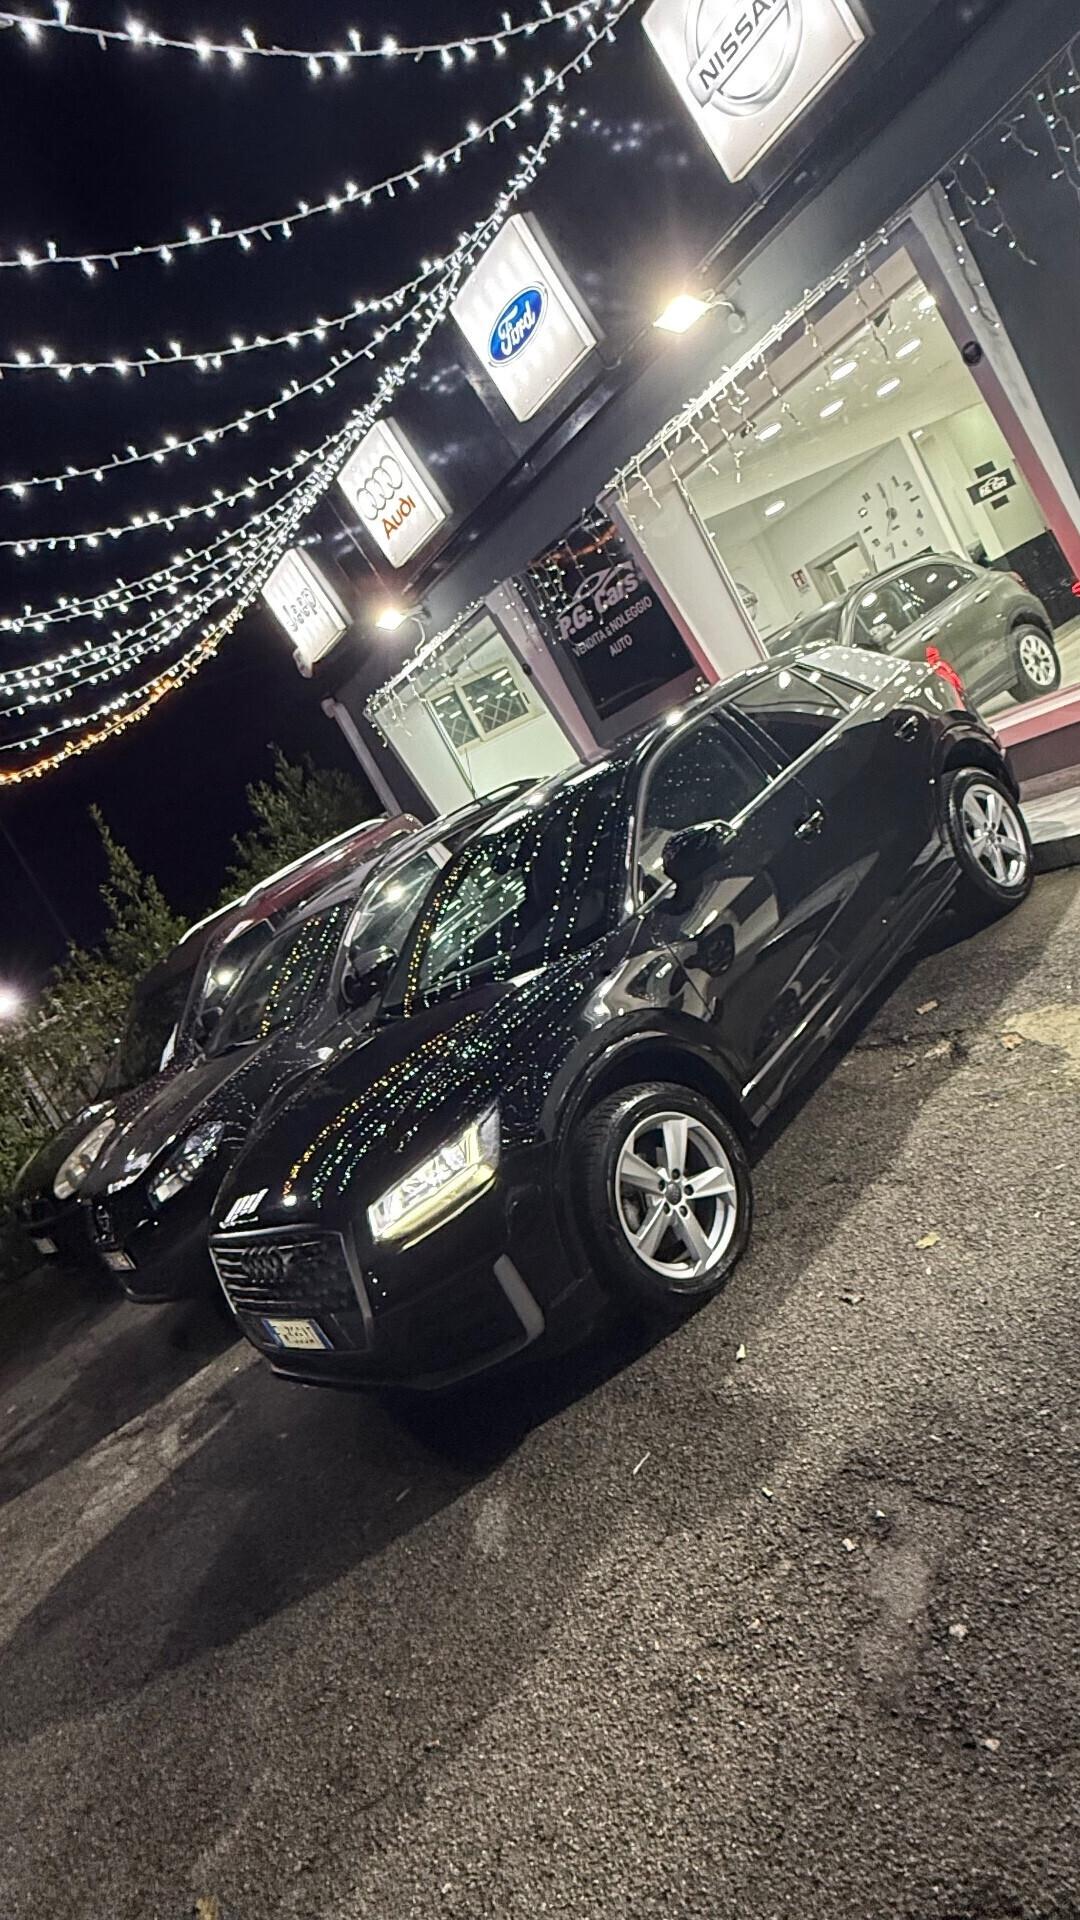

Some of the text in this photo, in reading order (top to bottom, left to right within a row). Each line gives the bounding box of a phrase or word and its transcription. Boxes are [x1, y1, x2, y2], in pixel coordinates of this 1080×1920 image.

[699, 0, 777, 90] NISSA
[498, 300, 535, 356] Ford
[382, 494, 416, 540] Audi
[282, 587, 317, 632] Jeep
[594, 573, 639, 613] Cars
[572, 629, 607, 657] VENDITA
[609, 595, 653, 633] NOLEGGIO
[609, 634, 633, 657] AUTO
